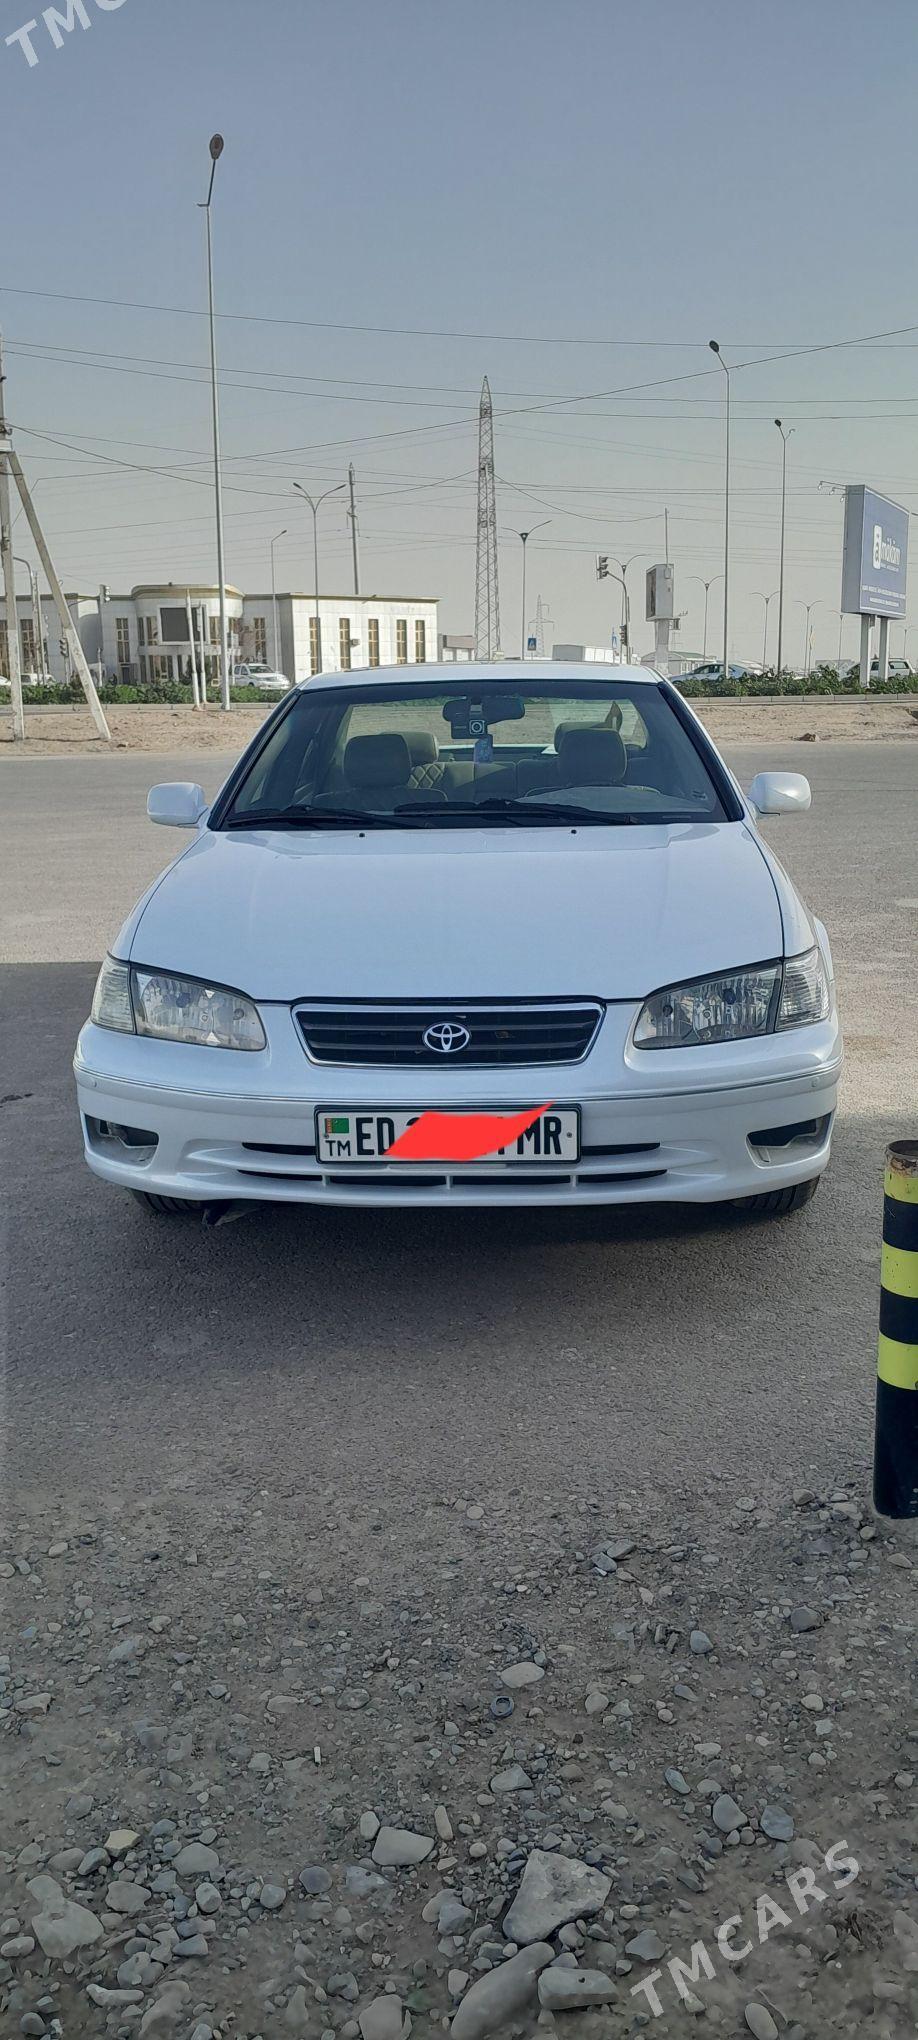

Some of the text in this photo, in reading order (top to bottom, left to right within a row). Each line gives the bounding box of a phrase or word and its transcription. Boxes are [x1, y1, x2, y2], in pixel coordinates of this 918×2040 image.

[325, 1140, 351, 1157] TM
[355, 1117, 395, 1155] ED
[516, 1116, 562, 1156] MR
